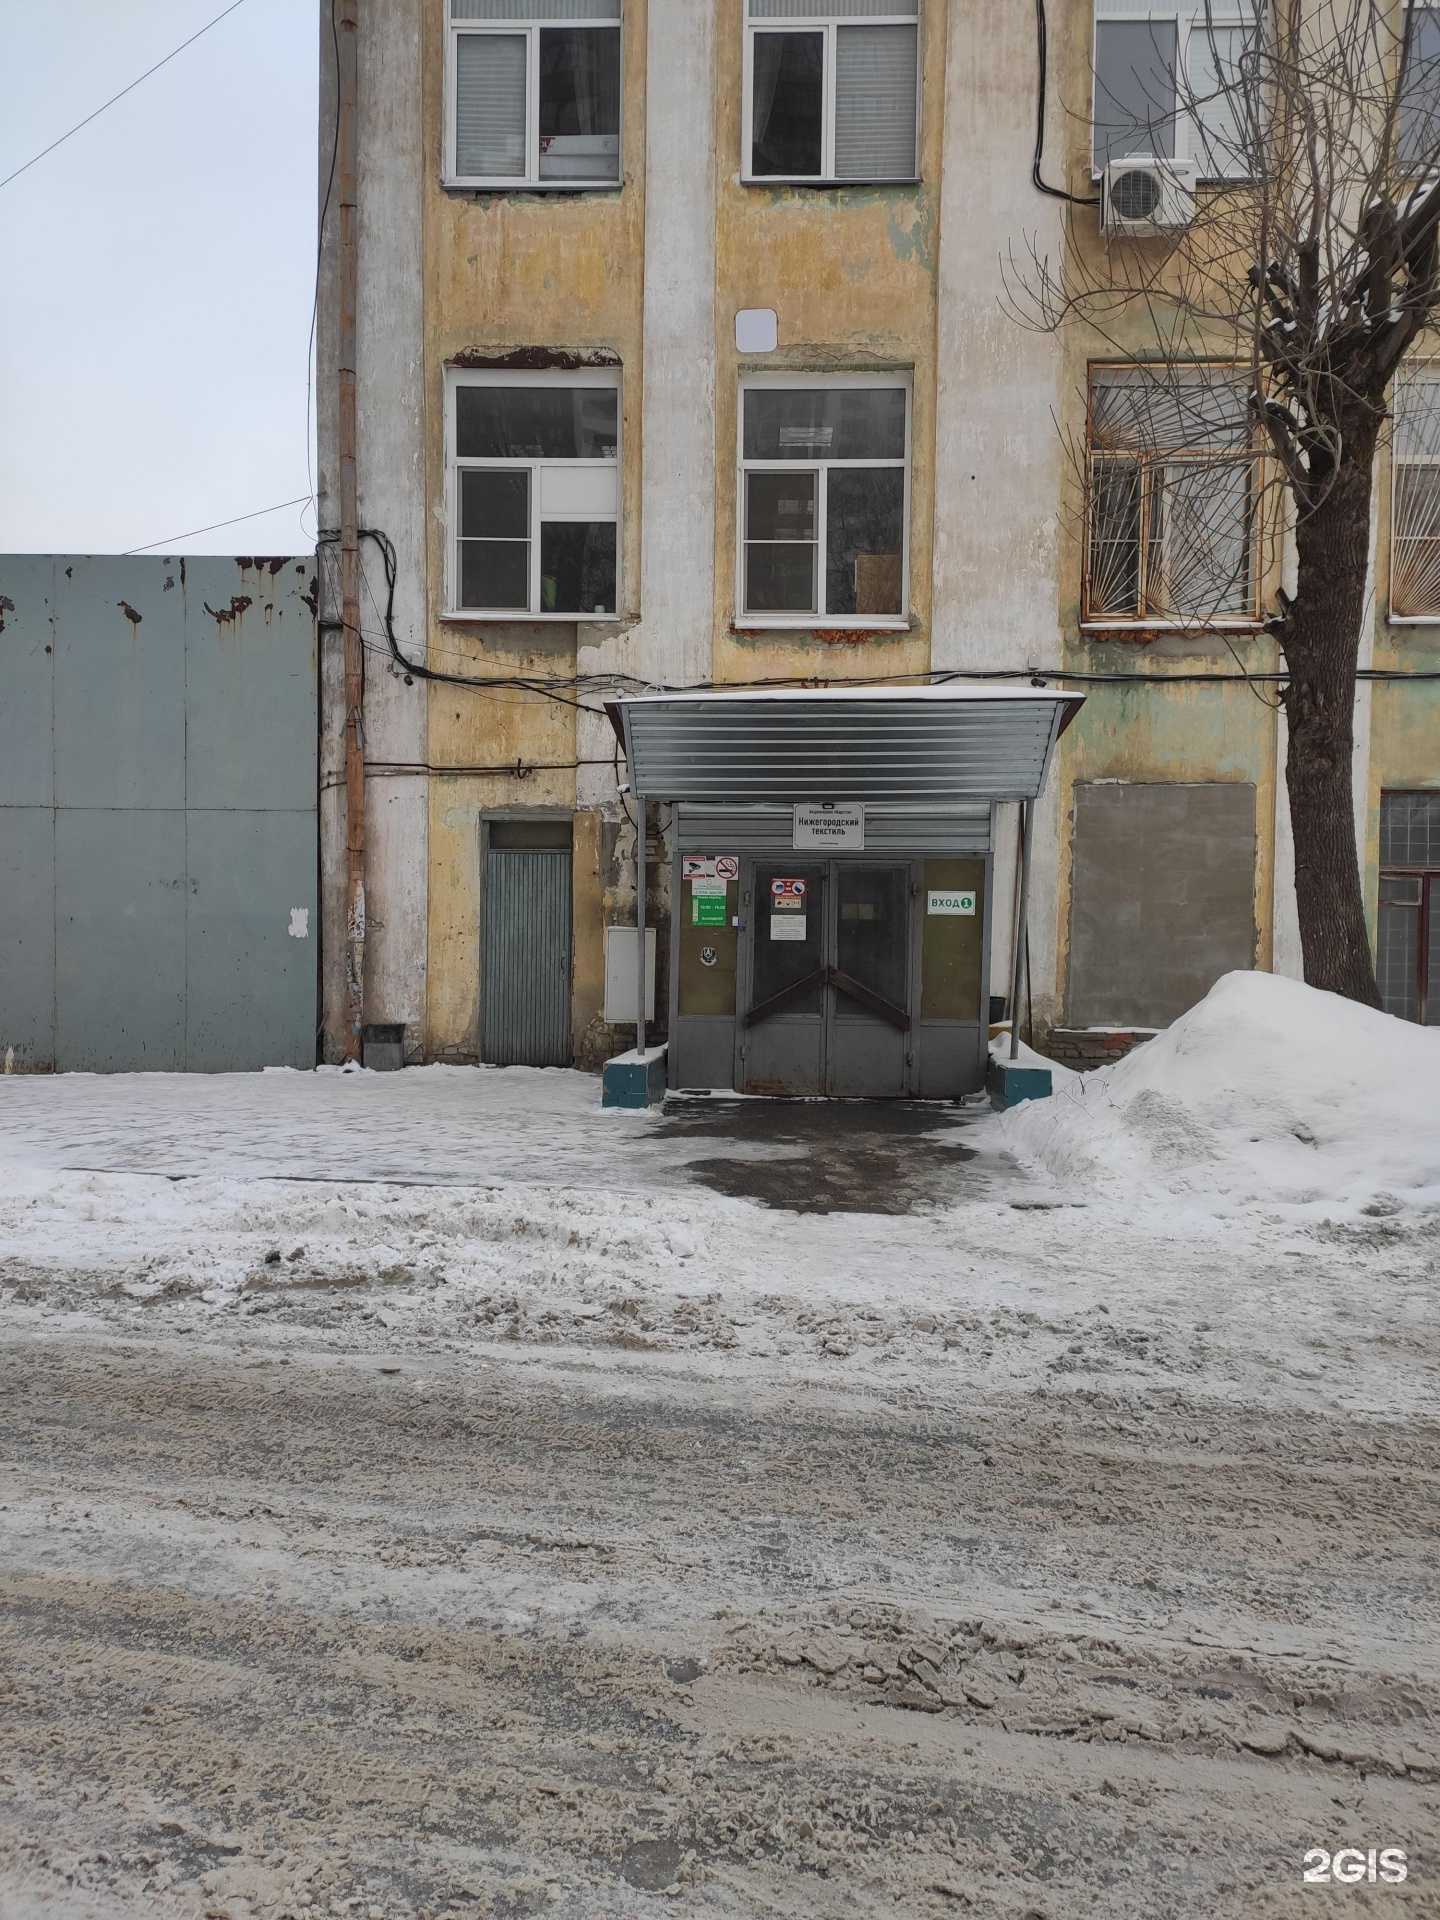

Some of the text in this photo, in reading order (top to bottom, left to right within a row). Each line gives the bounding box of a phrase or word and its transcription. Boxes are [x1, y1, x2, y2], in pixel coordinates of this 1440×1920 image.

[798, 816, 859, 827] Нижегородский
[812, 828, 846, 836] текстиль
[931, 898, 960, 908] ВХОД
